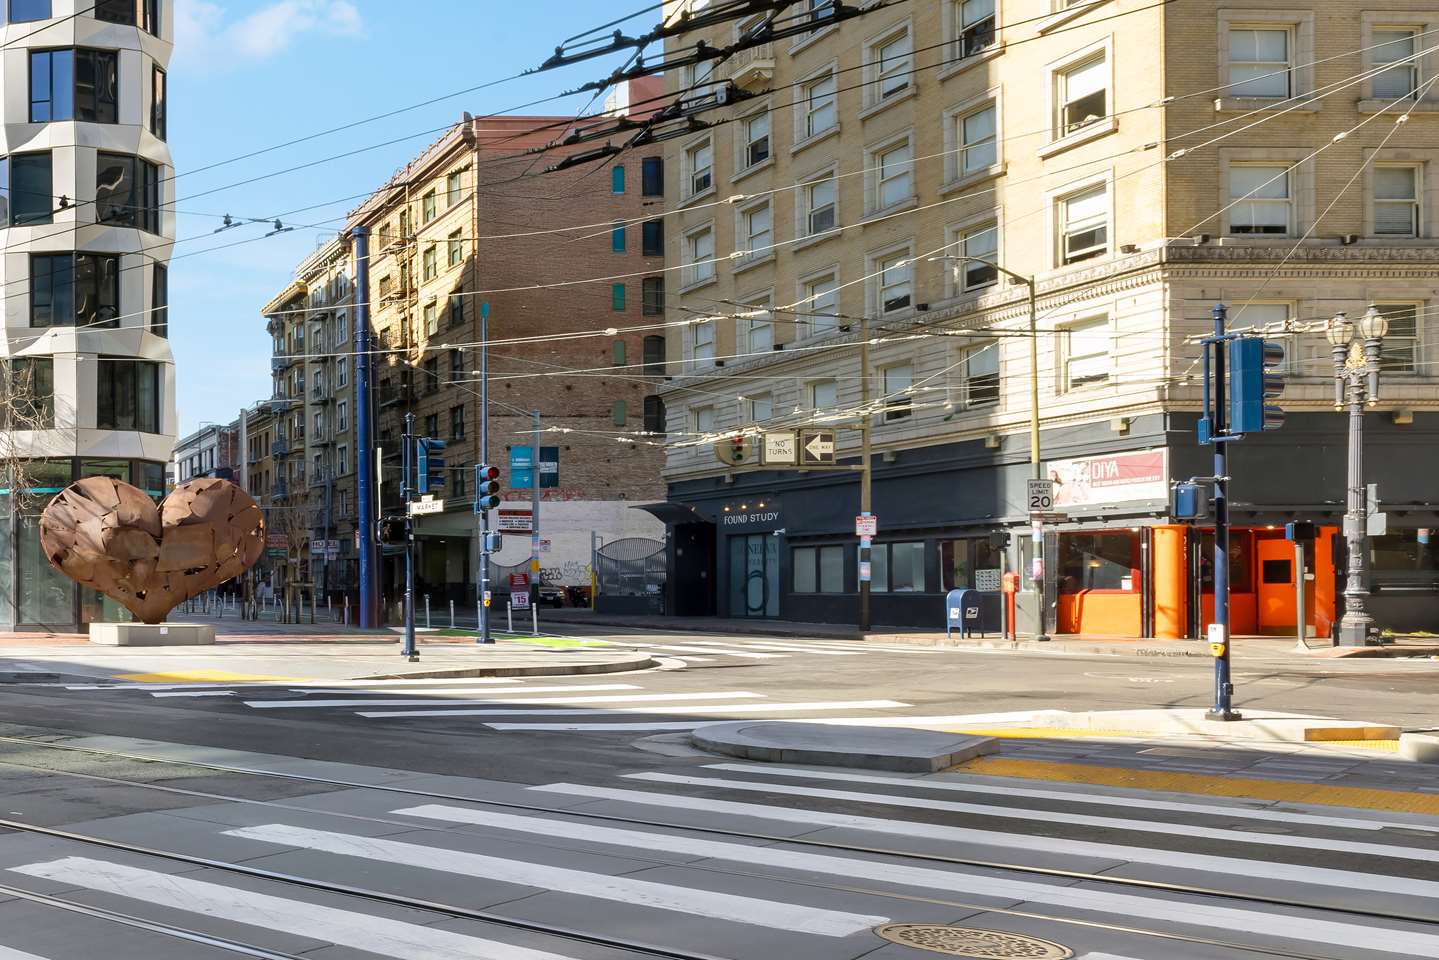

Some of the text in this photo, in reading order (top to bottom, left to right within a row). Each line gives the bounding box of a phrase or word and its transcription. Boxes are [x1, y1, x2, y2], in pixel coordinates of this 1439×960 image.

[1092, 460, 1120, 479] DIYA
[1031, 496, 1050, 507] 20
[724, 512, 779, 525] FOUND STUDY
